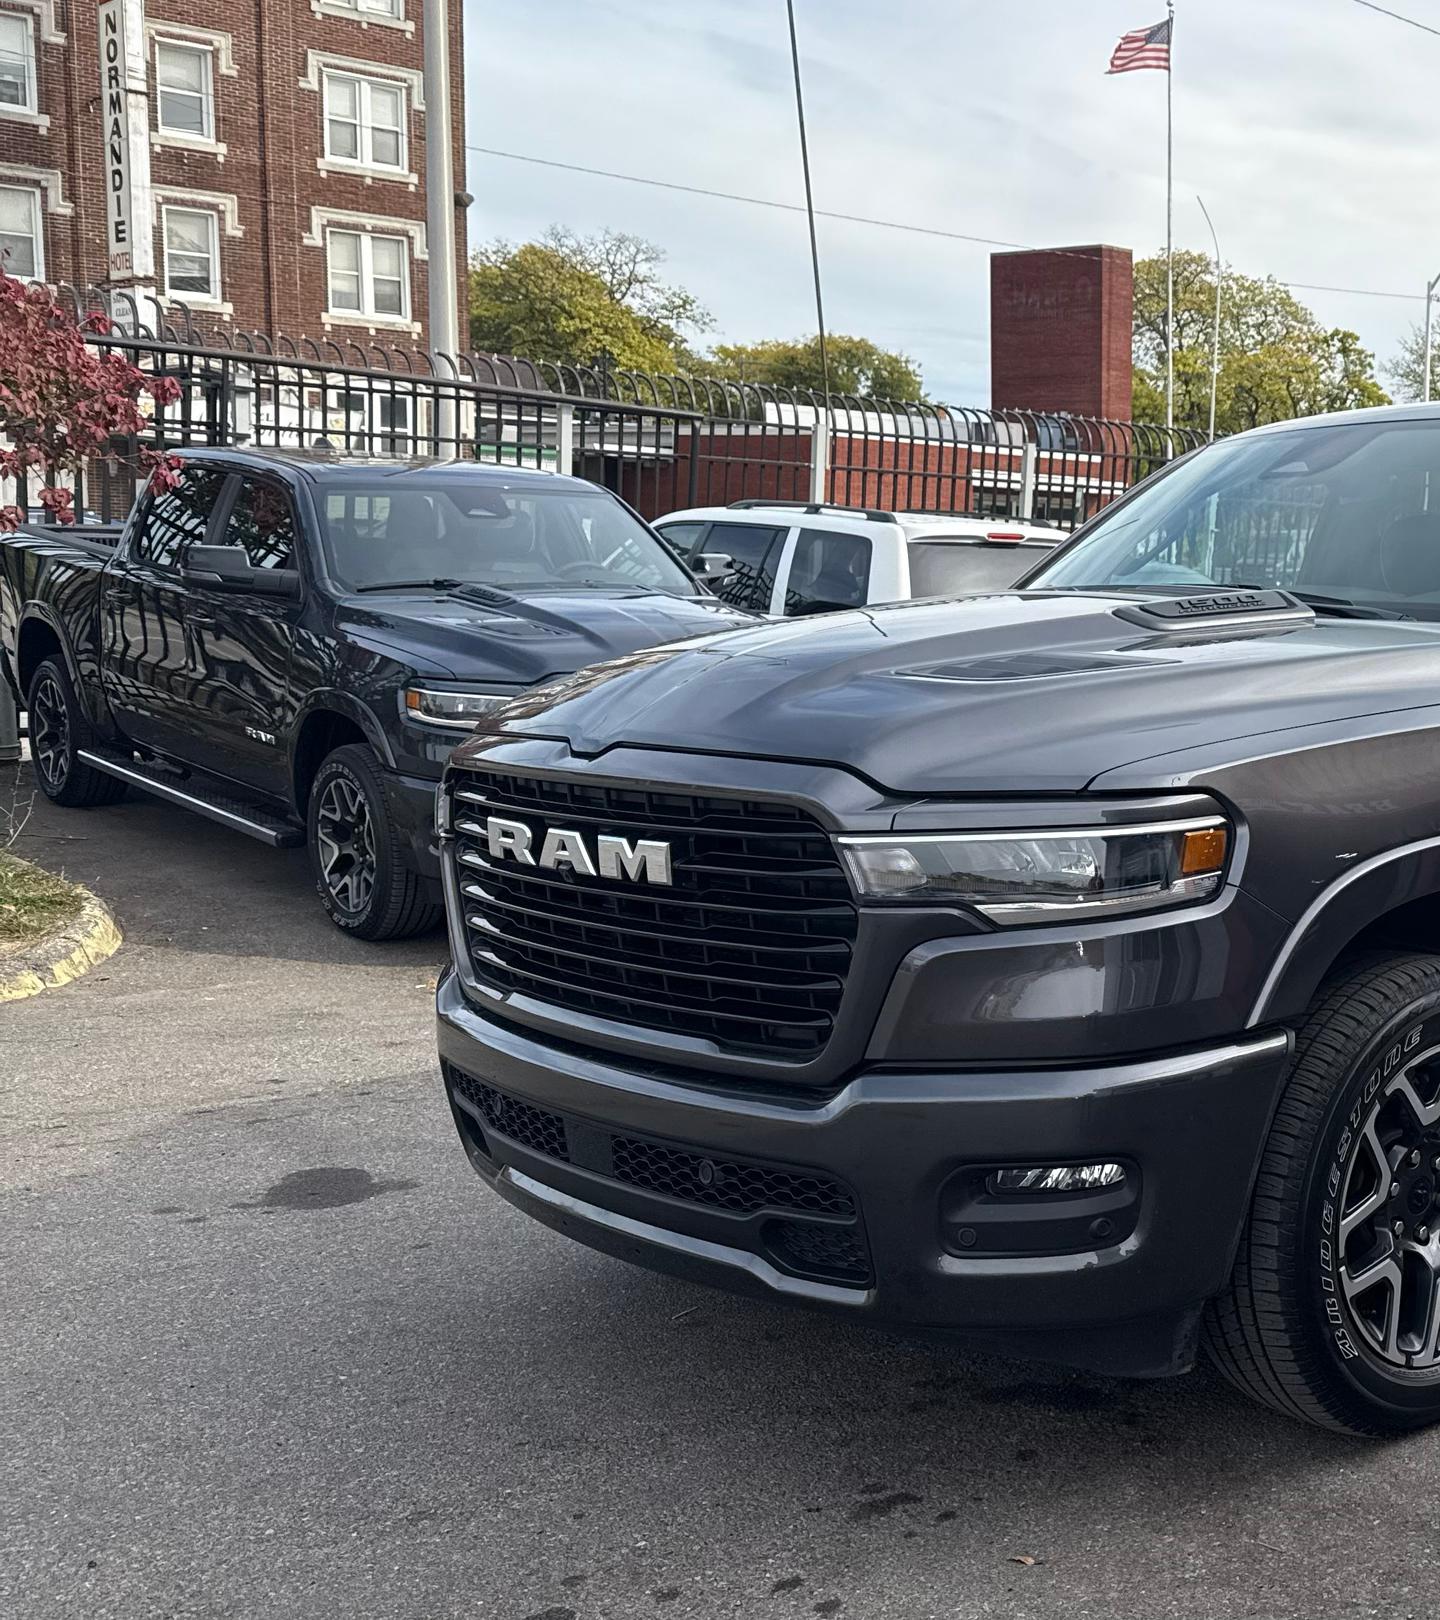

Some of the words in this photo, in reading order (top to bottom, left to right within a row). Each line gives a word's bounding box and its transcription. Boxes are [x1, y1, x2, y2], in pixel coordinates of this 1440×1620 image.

[105, 10, 128, 243] NORMANDIE
[110, 251, 132, 272] HOTEL
[1175, 595, 1263, 610] 1500
[487, 816, 673, 886] RAM
[1320, 1024, 1424, 1360] BRIDGESTONE
